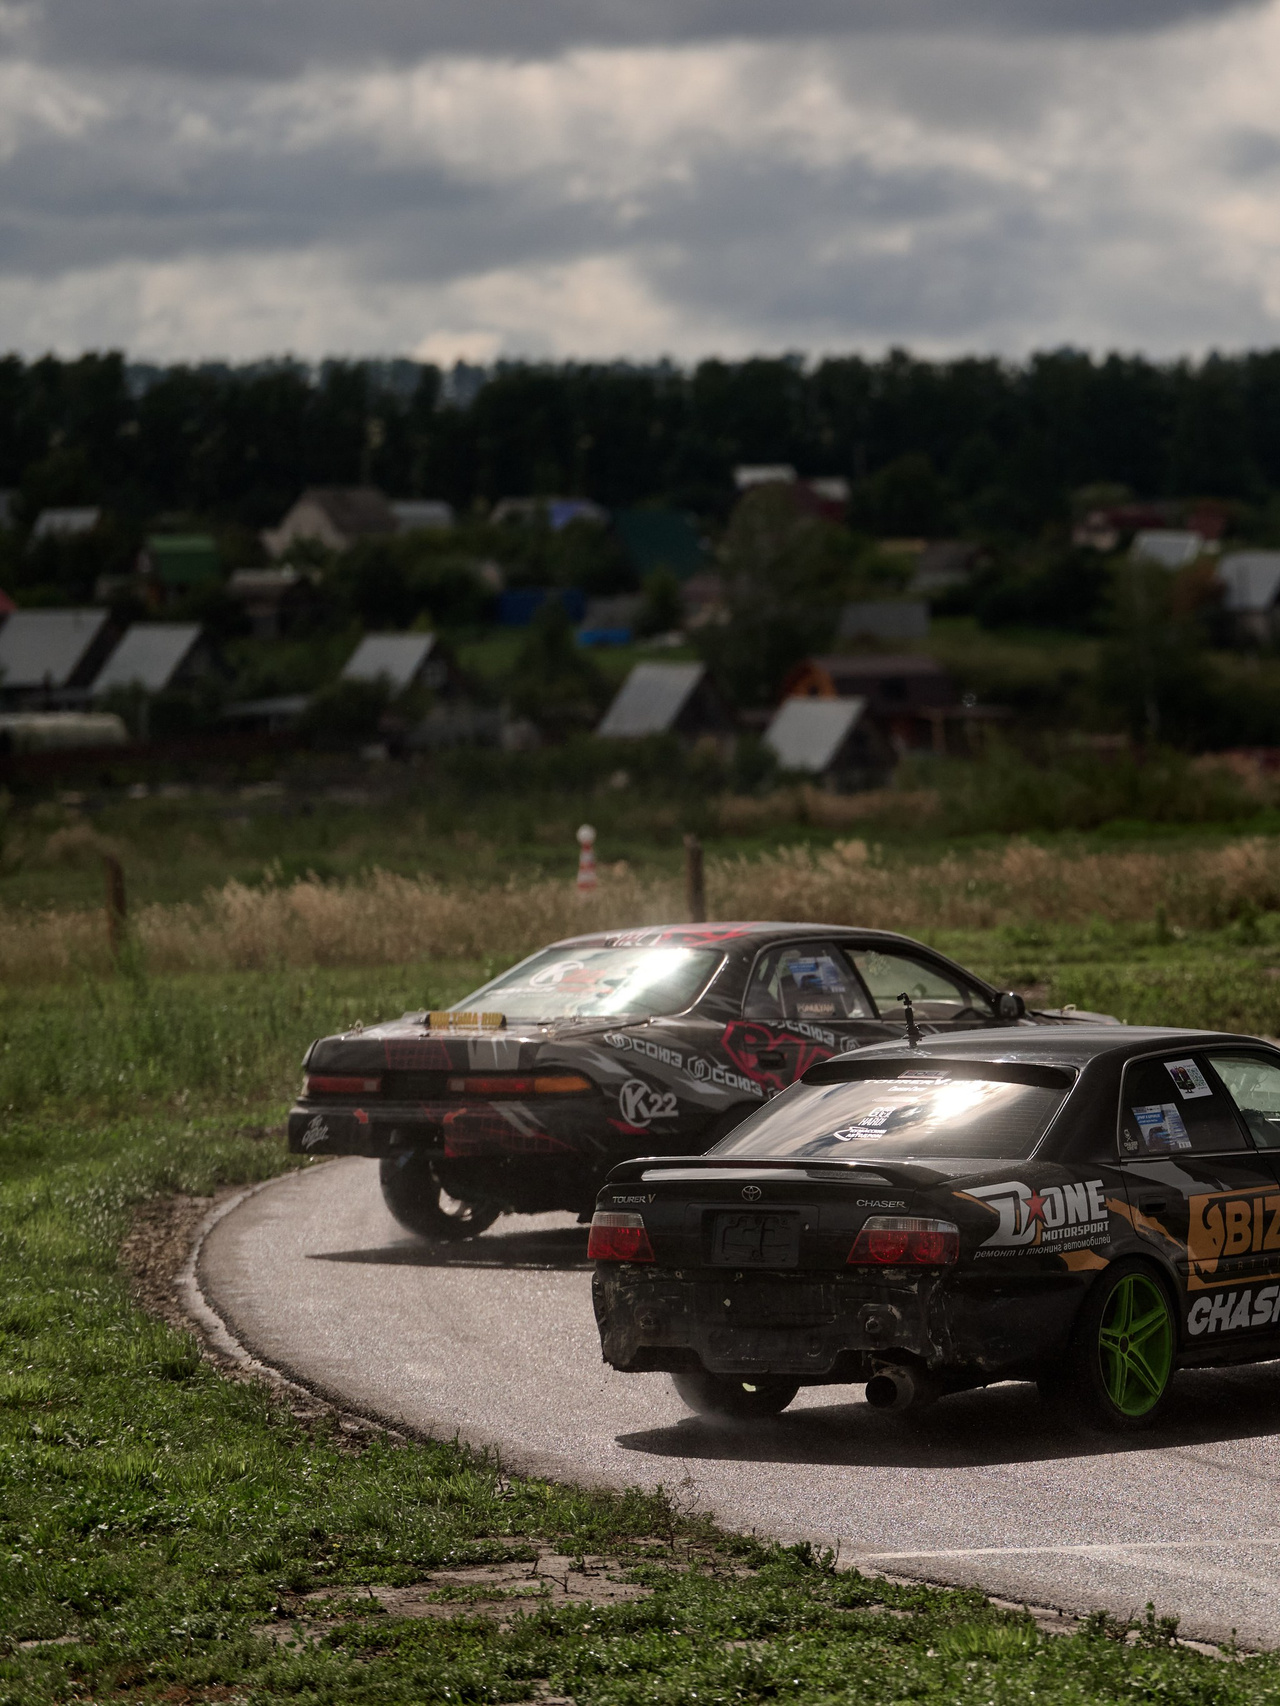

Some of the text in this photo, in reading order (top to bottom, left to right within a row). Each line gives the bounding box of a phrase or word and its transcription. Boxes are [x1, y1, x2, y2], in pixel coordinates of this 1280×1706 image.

[631, 1039, 683, 1069] СОЮЗ
[710, 1071, 764, 1097] СОЮЗ
[619, 1079, 680, 1127] K22
[612, 1193, 656, 1204] TOURER V
[856, 1199, 907, 1209] CHASER
[1042, 1221, 1110, 1242] MOTORSPORT
[974, 1233, 1111, 1260] ремонт и тюнинг автомобилей
